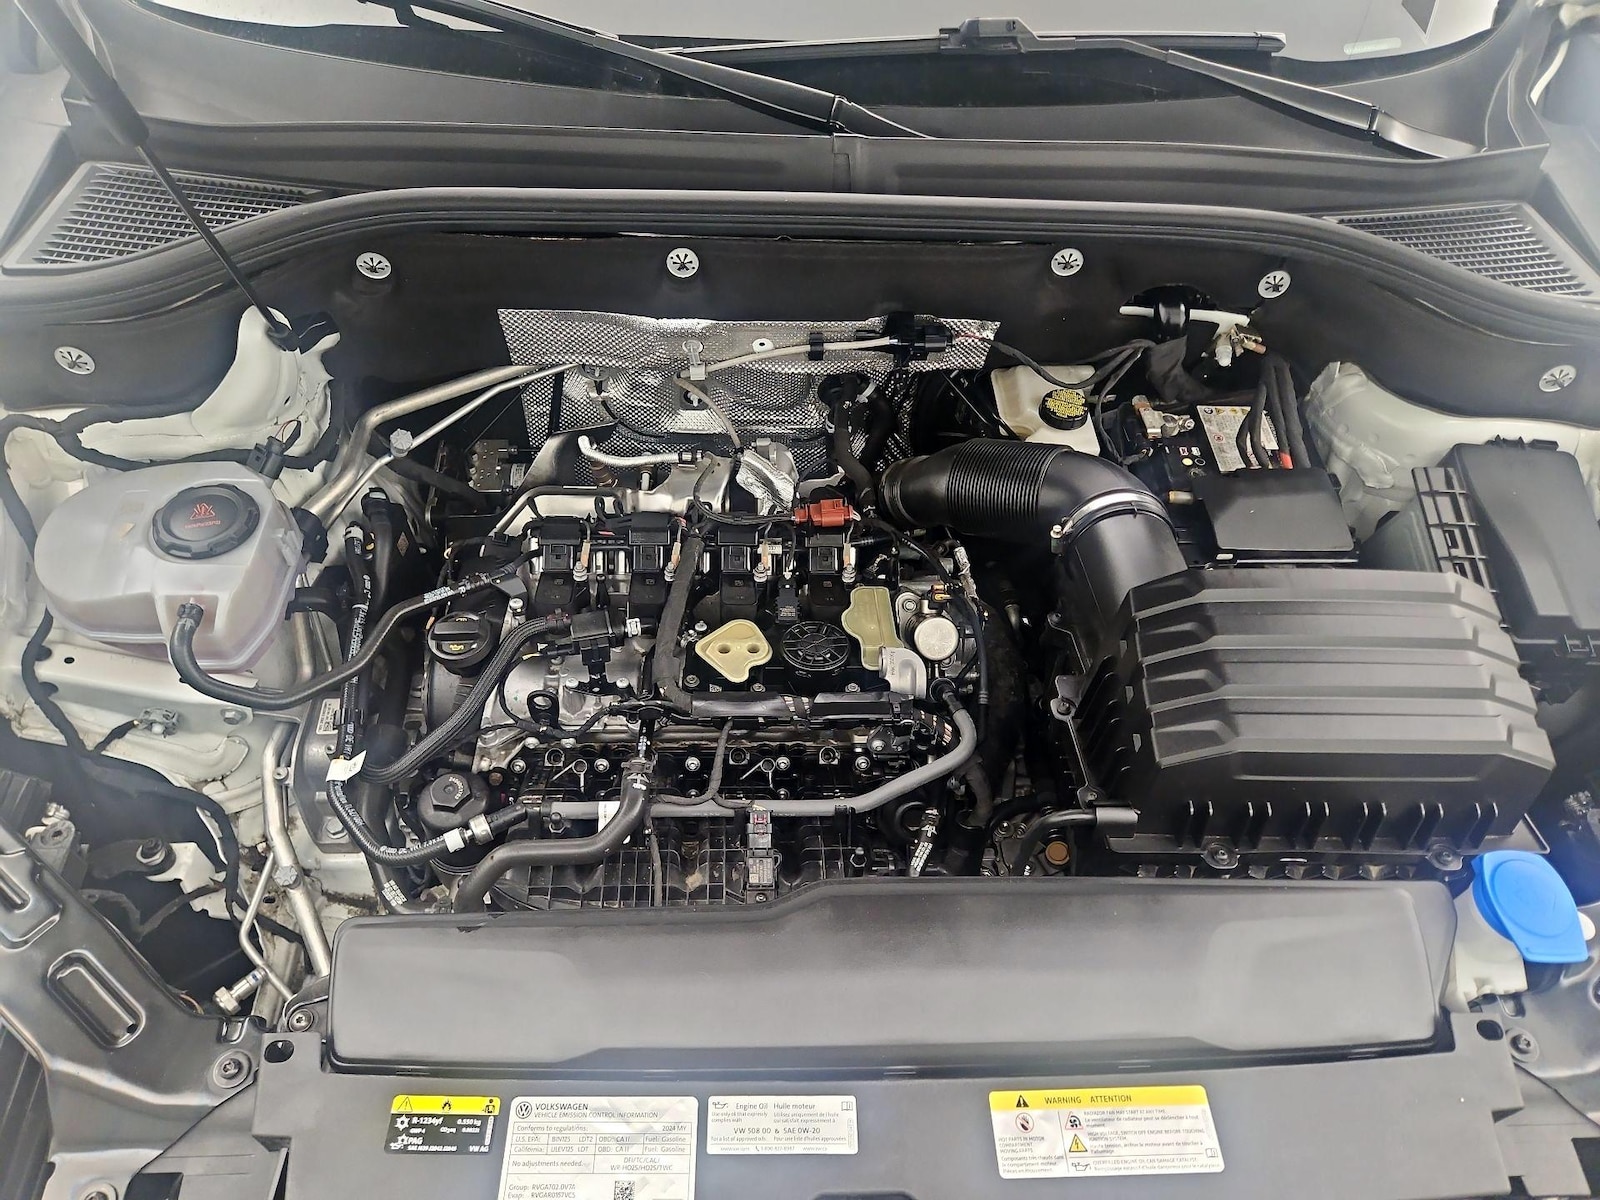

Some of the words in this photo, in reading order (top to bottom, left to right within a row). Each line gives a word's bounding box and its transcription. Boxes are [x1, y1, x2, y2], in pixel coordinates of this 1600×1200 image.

[1090, 1095, 1132, 1103] ATTENTION
[535, 1103, 589, 1111] VOLKSWAGEN
[735, 1103, 758, 1111] Engine
[408, 1137, 423, 1145] PAG
[521, 1160, 559, 1168] adjustments
